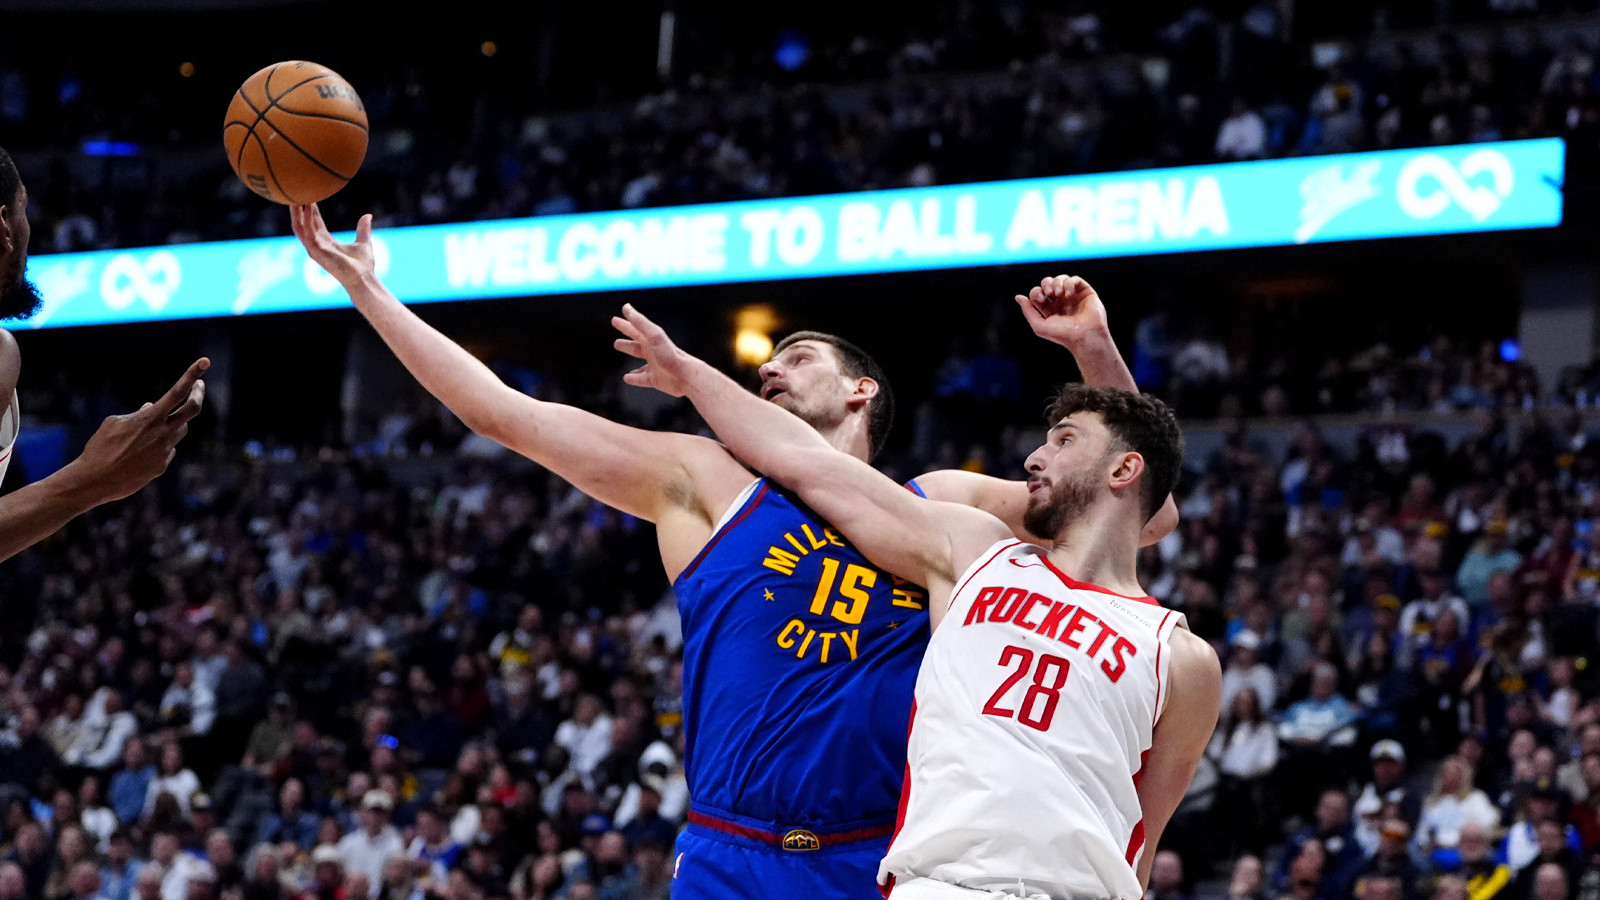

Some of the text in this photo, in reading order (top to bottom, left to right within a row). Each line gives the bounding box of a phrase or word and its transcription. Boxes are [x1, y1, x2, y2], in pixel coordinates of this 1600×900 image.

[444, 213, 729, 288] WELCOME
[741, 206, 824, 268] TO
[836, 194, 993, 262] BALL
[1004, 175, 1231, 251] ARENA
[809, 557, 878, 625] 15
[962, 586, 1137, 683] ROCKETS
[776, 619, 860, 664] CITY
[981, 645, 1070, 732] 28
